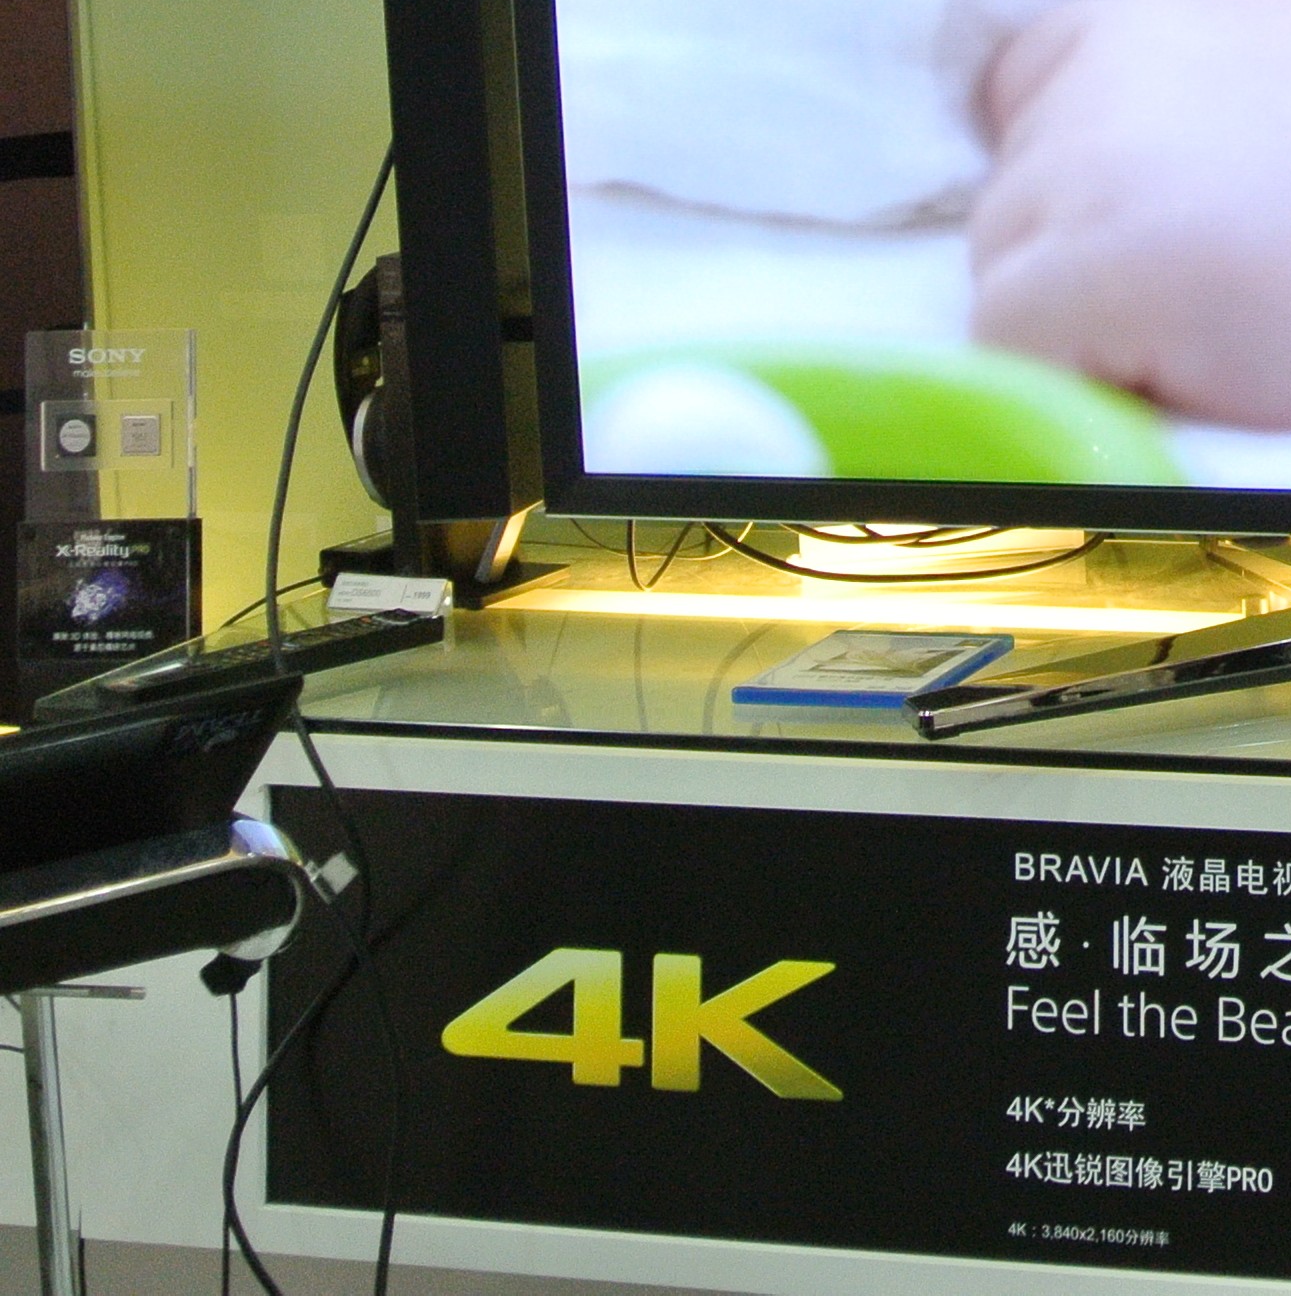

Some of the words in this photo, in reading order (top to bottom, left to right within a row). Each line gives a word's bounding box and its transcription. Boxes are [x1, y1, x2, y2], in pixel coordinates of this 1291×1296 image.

[68, 348, 146, 364] SONY
[56, 544, 130, 558] X-Reality
[1014, 852, 1149, 887] BRAVIA
[440, 946, 845, 1102] 4K
[1006, 984, 1101, 1036] Feel
[1117, 991, 1199, 1041] the
[1005, 1151, 1274, 1194] 4K迅锐图像引擎PRO
